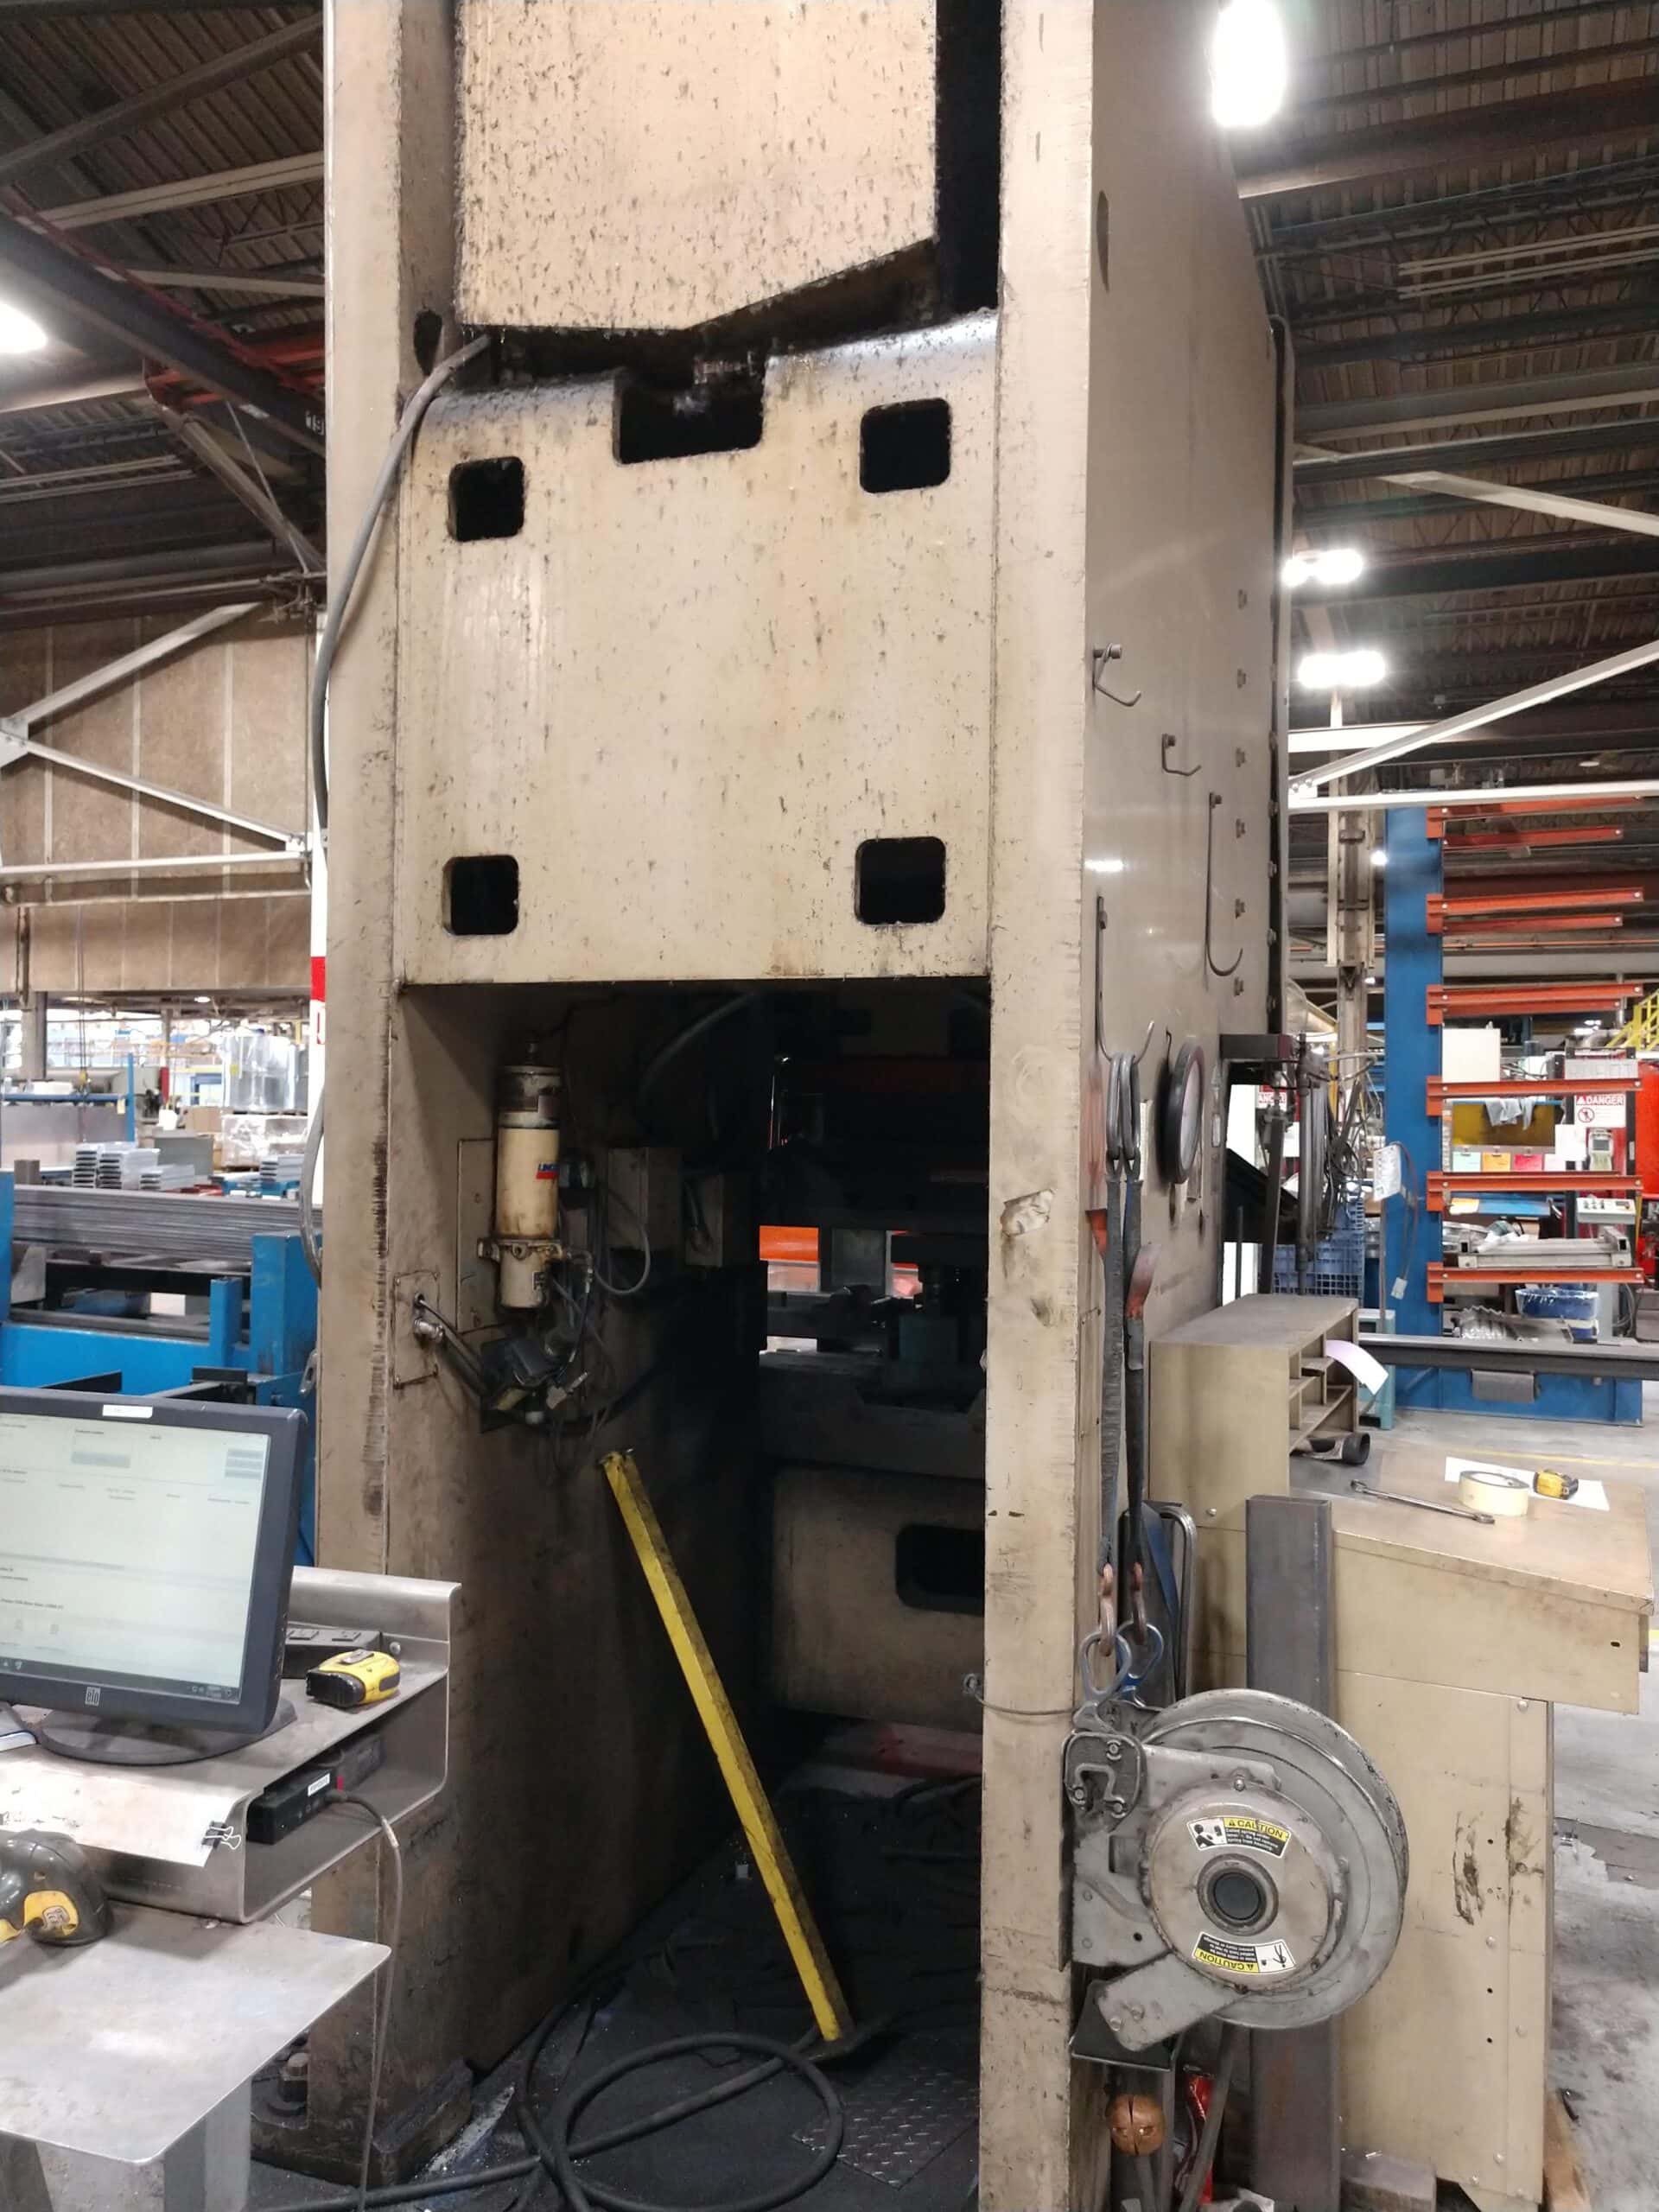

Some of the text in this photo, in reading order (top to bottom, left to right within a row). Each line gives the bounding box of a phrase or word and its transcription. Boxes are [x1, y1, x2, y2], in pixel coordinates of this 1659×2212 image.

[1586, 1094, 1624, 1105] DANGER
[1237, 1820, 1283, 1839] CAUTION
[1199, 1951, 1244, 1970] CAUTION
